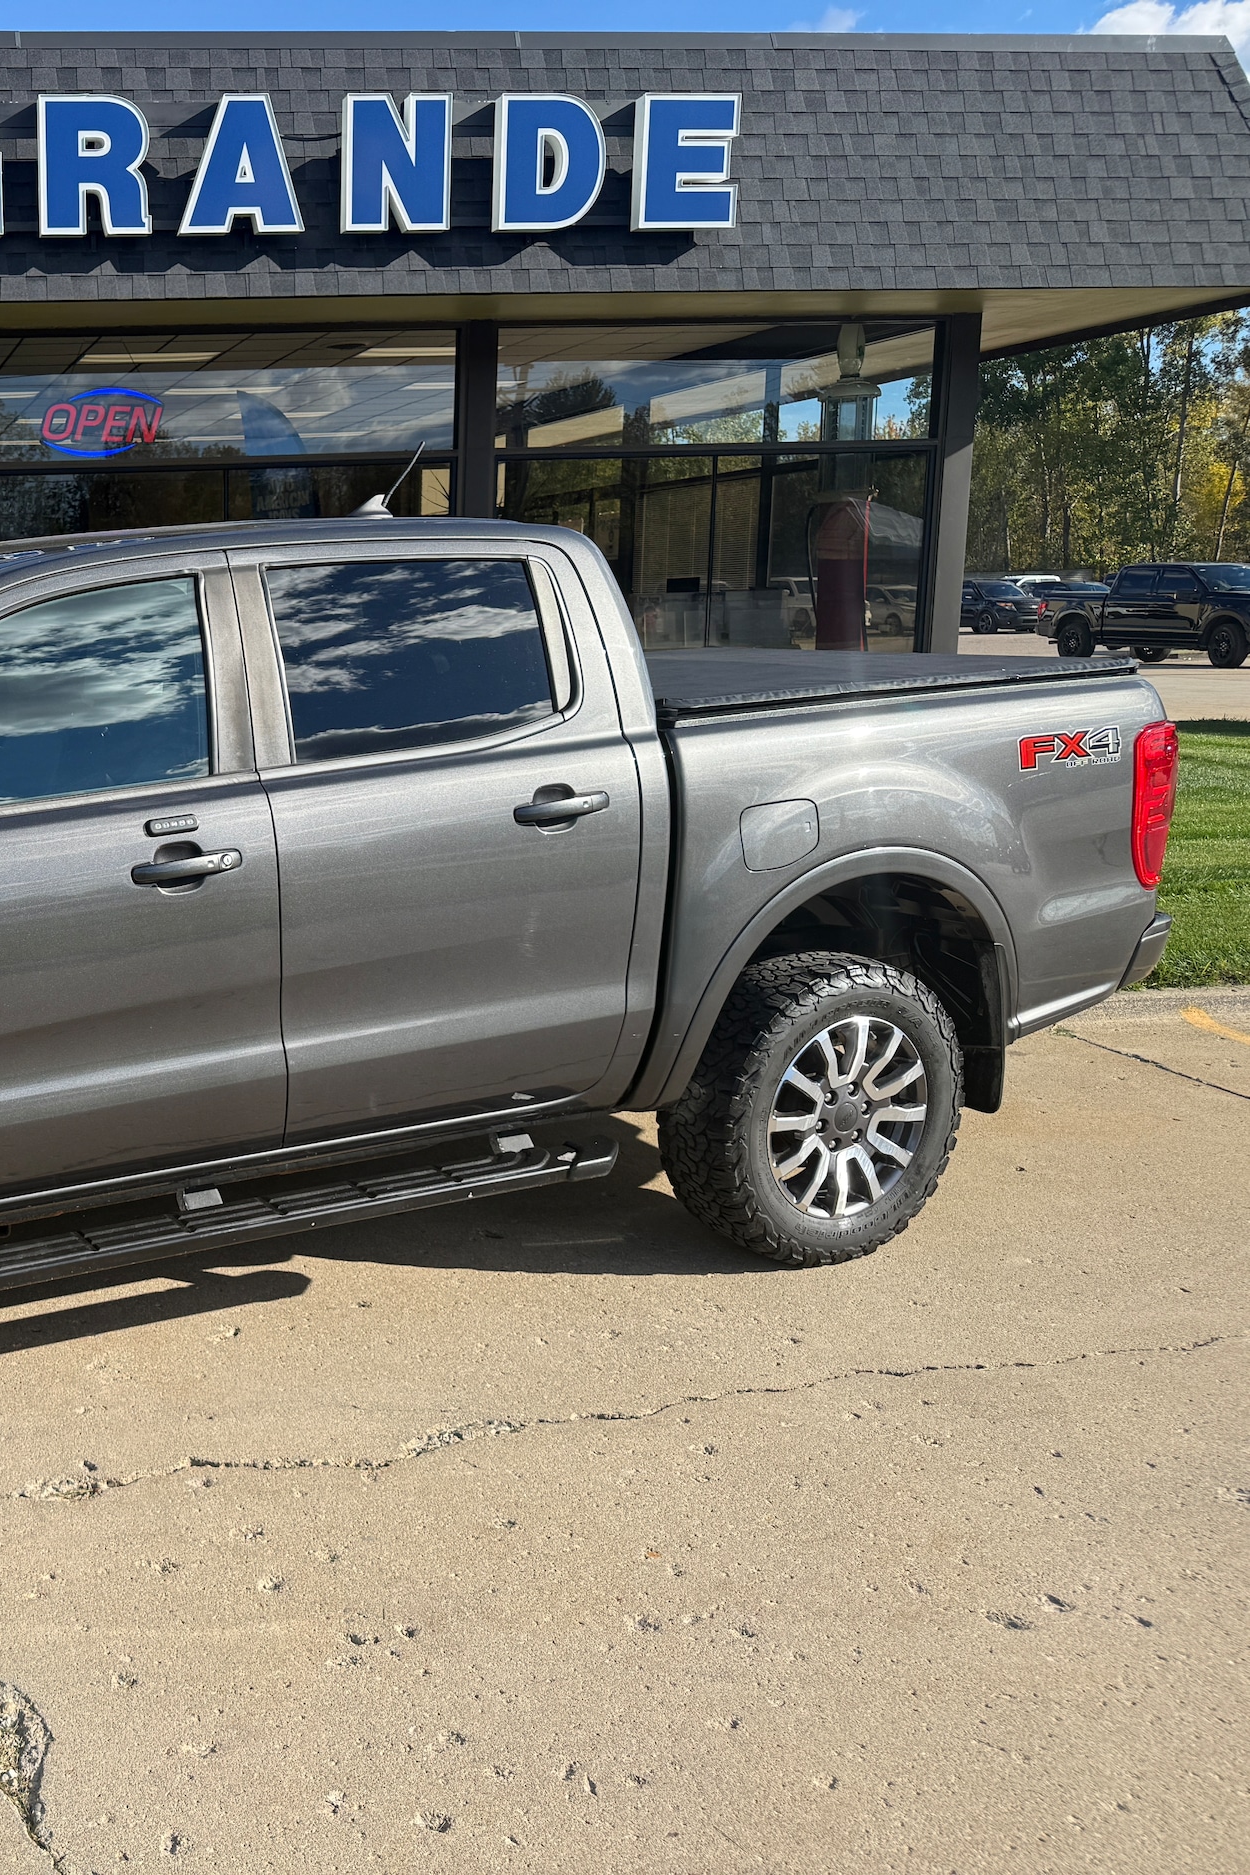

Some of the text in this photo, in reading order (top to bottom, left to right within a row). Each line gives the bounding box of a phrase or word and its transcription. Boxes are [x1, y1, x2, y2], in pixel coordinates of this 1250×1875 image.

[41, 403, 163, 443] OPEN
[1017, 725, 1121, 772] FX4
[1065, 758, 1088, 768] OFF
